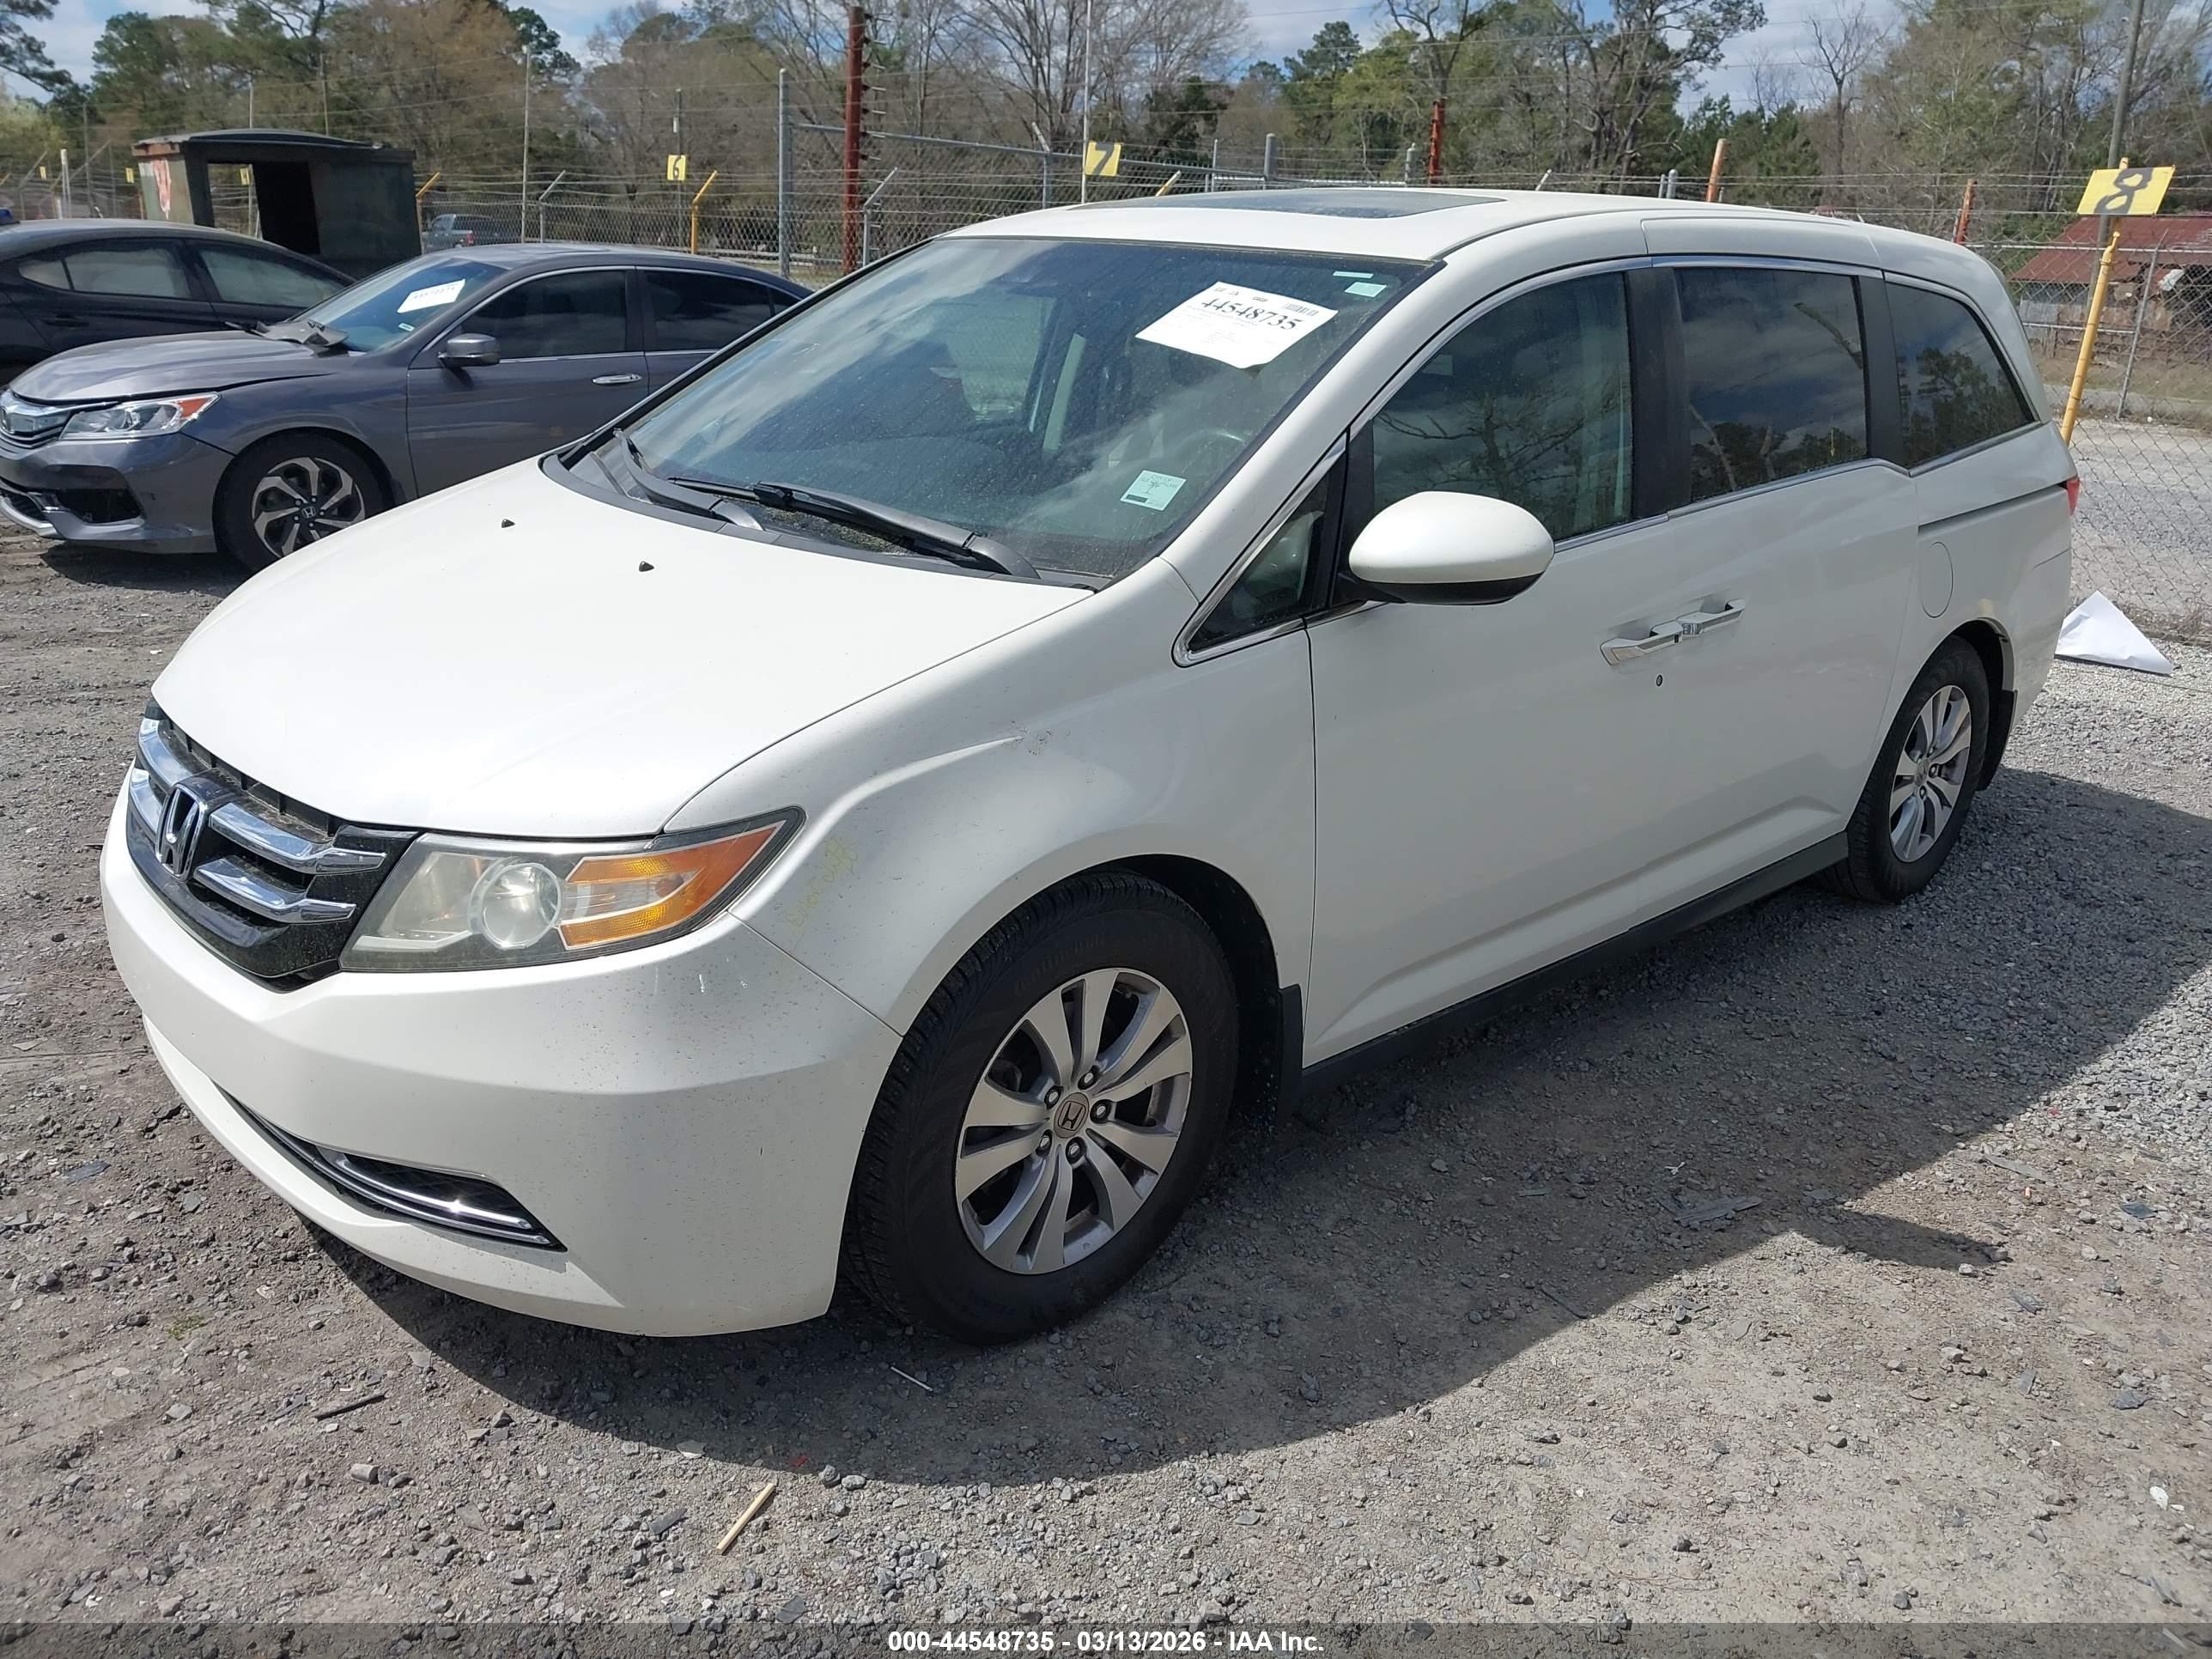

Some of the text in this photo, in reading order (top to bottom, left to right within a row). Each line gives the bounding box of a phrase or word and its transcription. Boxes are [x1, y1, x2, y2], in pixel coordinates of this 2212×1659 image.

[672, 155, 682, 180] 6
[1092, 142, 1115, 176] 7
[2093, 167, 2154, 215] 8
[1200, 297, 1305, 331] 44548735
